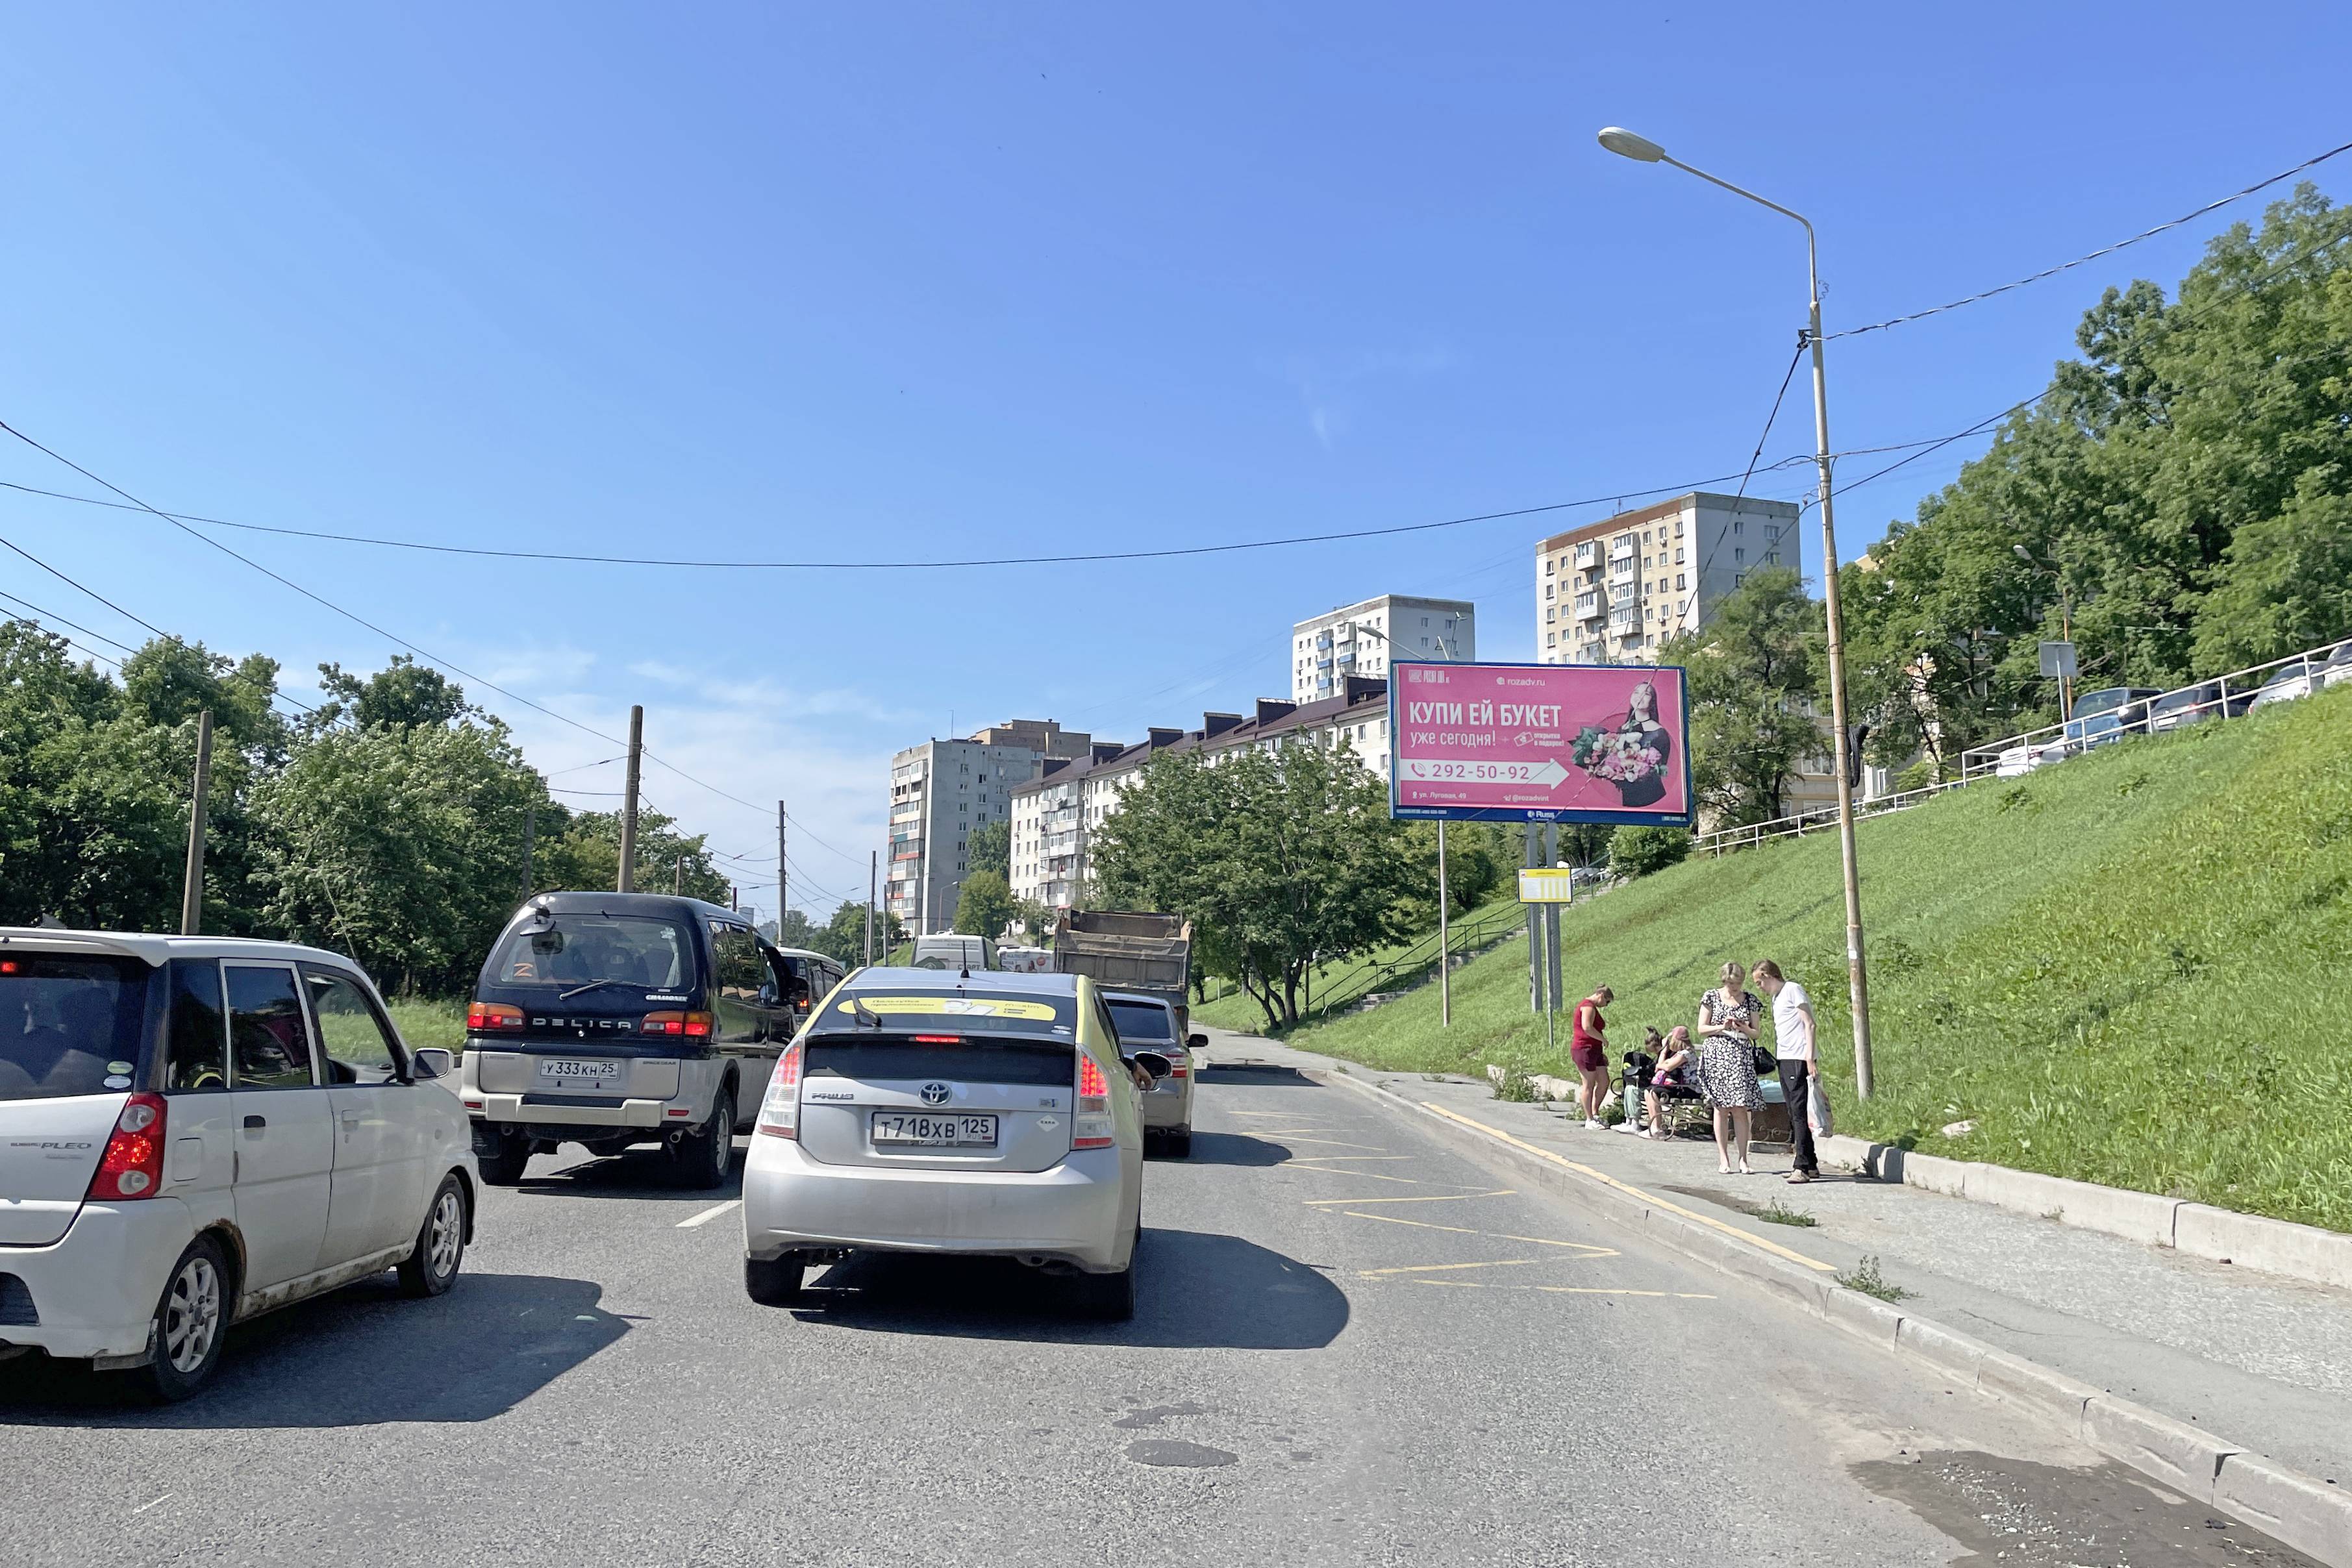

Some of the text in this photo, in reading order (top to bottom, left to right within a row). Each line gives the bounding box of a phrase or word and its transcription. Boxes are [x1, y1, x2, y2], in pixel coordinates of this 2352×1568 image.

[1507, 677, 1545, 686] rozadv.ru
[1409, 699, 1562, 727] КУПИ ЕЙ БУКЕТ
[1410, 730, 1496, 748] уже сегодня!
[1432, 764, 1529, 780] 292-50-92
[1512, 794, 1549, 803] @rozadvint
[1536, 810, 1555, 819] Russ
[514, 963, 532, 977] Z
[532, 1017, 632, 1029] DELICA
[601, 1063, 614, 1073] 25
[961, 1118, 990, 1134] 125
